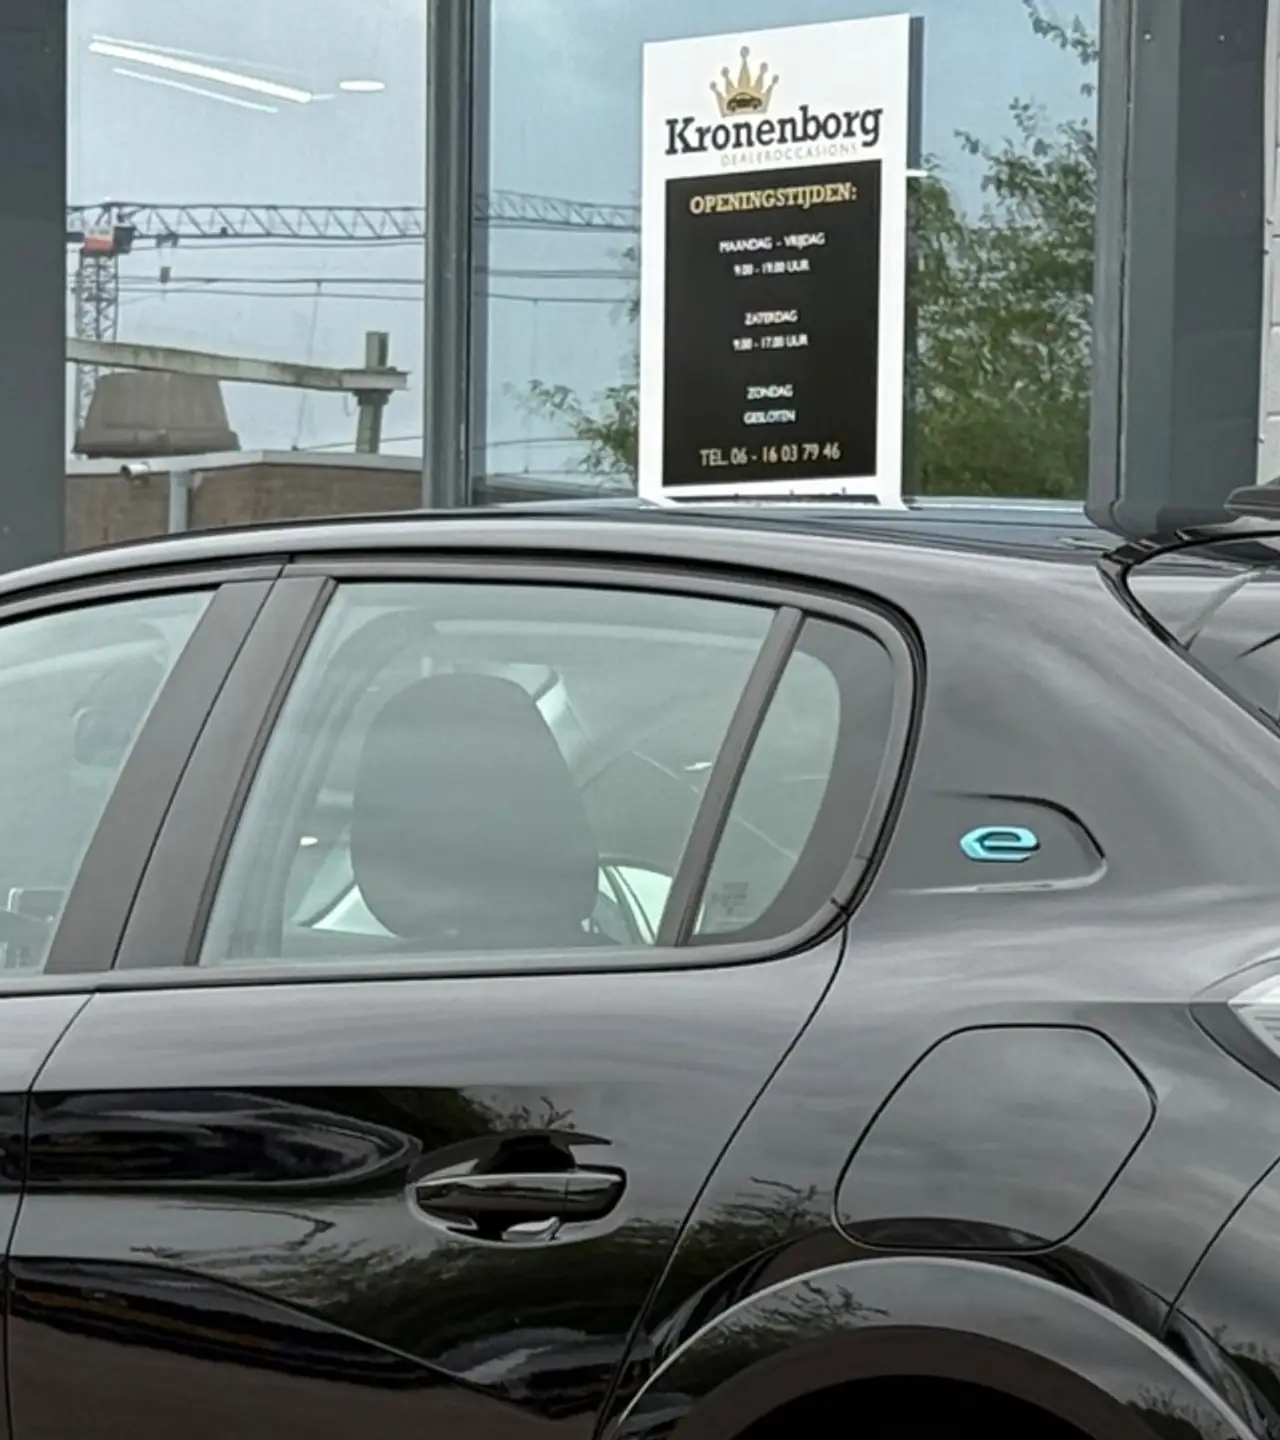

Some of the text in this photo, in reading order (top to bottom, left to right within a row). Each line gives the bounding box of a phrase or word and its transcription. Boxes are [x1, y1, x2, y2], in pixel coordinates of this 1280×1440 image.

[665, 104, 883, 155] Kronenborg
[721, 143, 857, 168] DEALEROCCASIONS
[689, 181, 858, 215] OPENINGSTIJDEN:
[719, 235, 773, 253] MAANDAG
[783, 231, 825, 251] VRIJDAG
[786, 258, 810, 274] UUR
[744, 309, 799, 326] ZATERDAG
[786, 332, 809, 348] UUR
[746, 383, 793, 400] ZONDAG
[743, 409, 796, 425] GESLOTEN
[730, 446, 748, 465] 06
[761, 446, 778, 463] 16
[780, 444, 798, 462] 03
[801, 442, 819, 461] 79
[822, 441, 840, 460] 46
